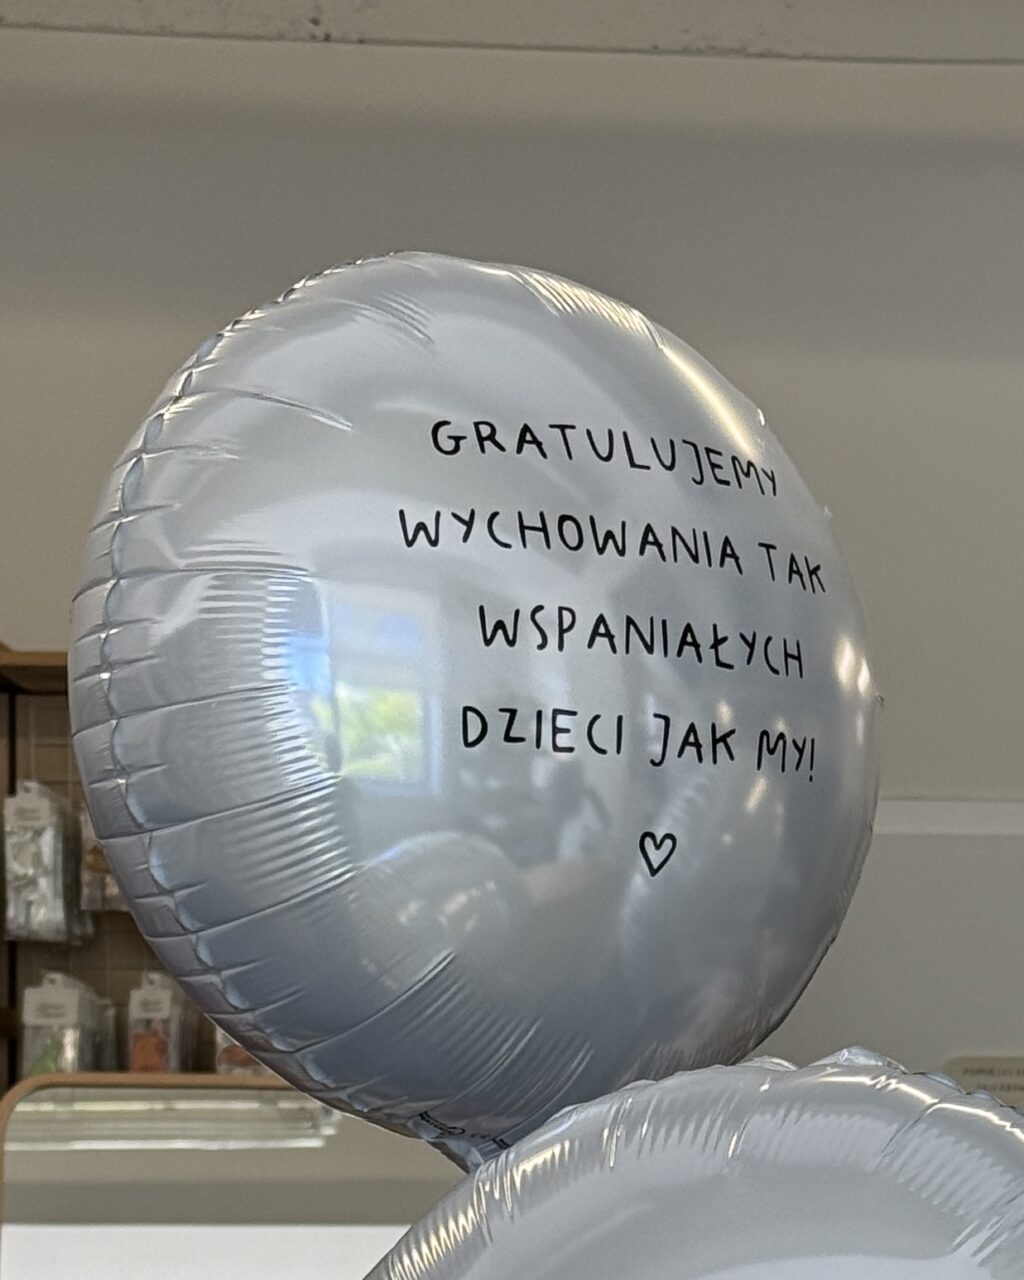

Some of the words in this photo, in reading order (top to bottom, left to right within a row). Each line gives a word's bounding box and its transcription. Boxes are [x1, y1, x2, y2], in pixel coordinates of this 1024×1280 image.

[431, 420, 777, 497] GRATULUJEMY
[398, 508, 743, 576] WYCHOWANIA
[757, 542, 826, 594] TAK
[478, 604, 804, 679] WSPANIAŁYCH
[461, 705, 623, 755] DZIECI
[649, 713, 737, 768] JAK
[756, 729, 816, 783] MY!
